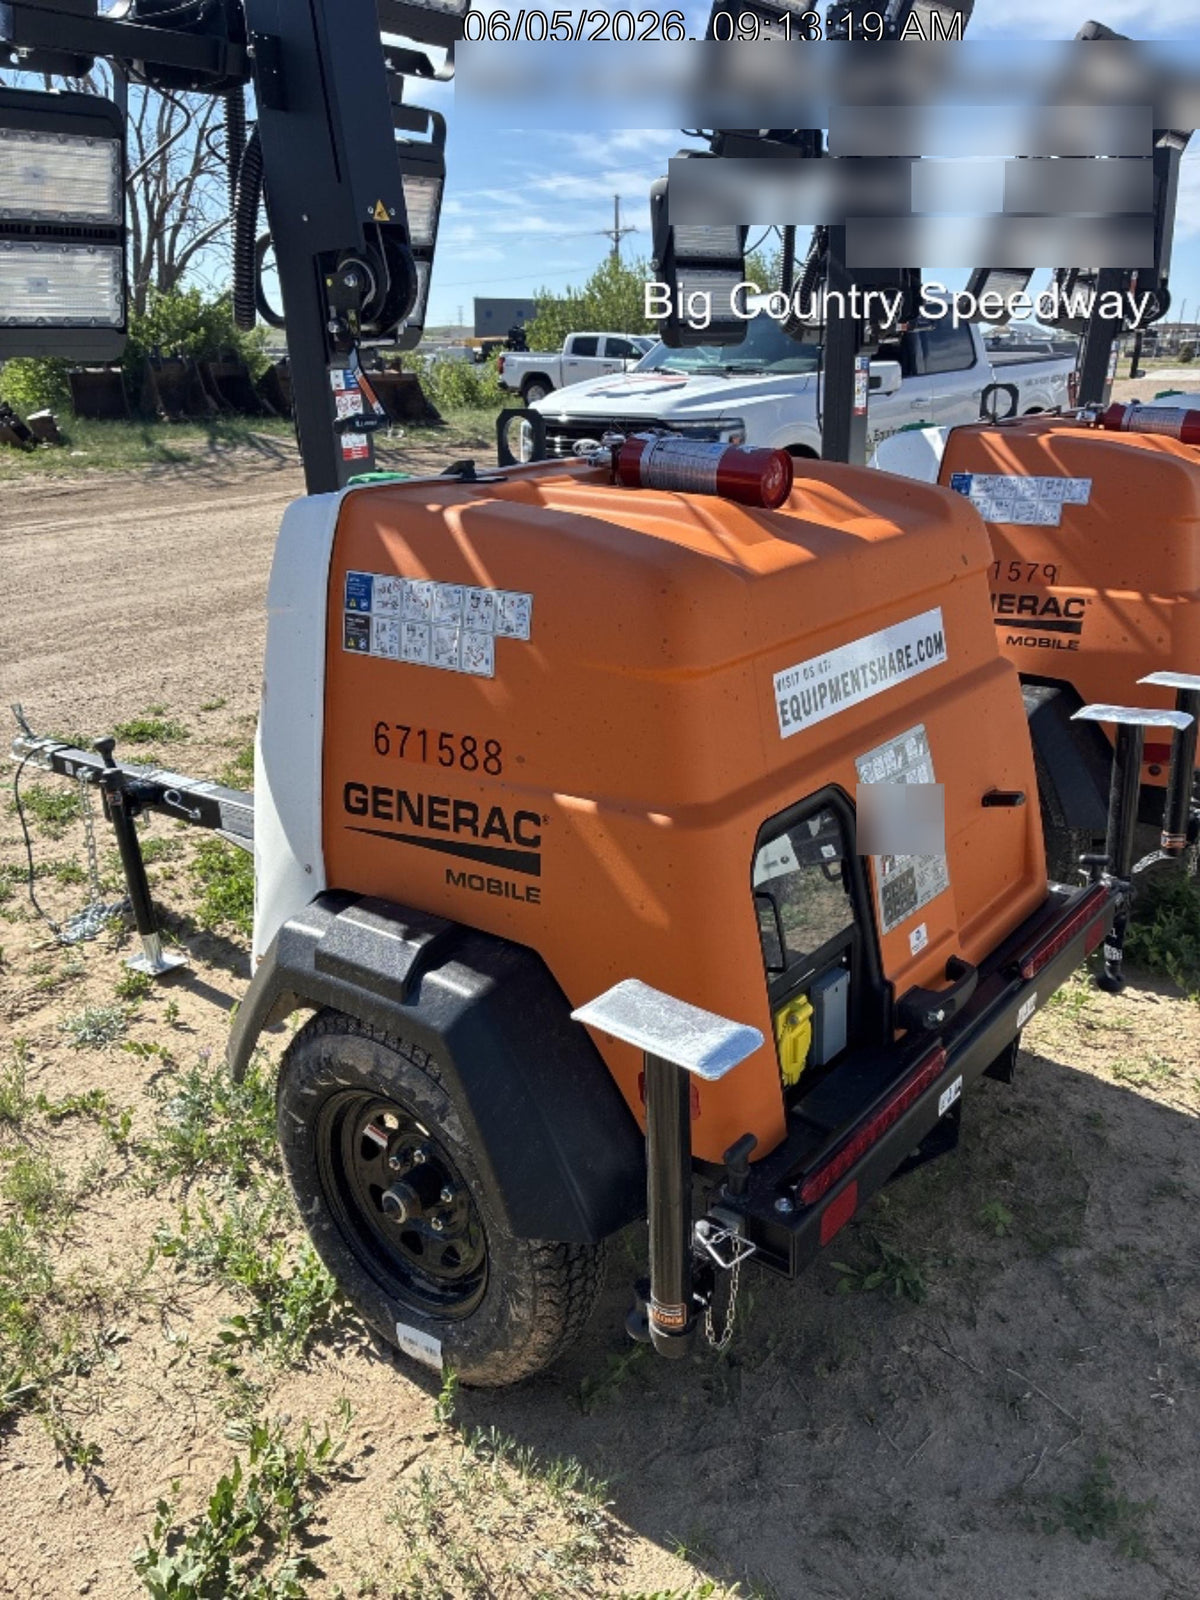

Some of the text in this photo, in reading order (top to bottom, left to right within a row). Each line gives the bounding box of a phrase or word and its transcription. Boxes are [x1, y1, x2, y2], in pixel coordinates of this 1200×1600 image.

[991, 593, 1085, 619] ERAC
[1006, 635, 1080, 651] MOBILE
[779, 630, 945, 727] EQUIPMENTSHARE.COM
[373, 721, 503, 776] 671588
[343, 781, 541, 848] GENERAC
[445, 868, 541, 904] MOBILE
